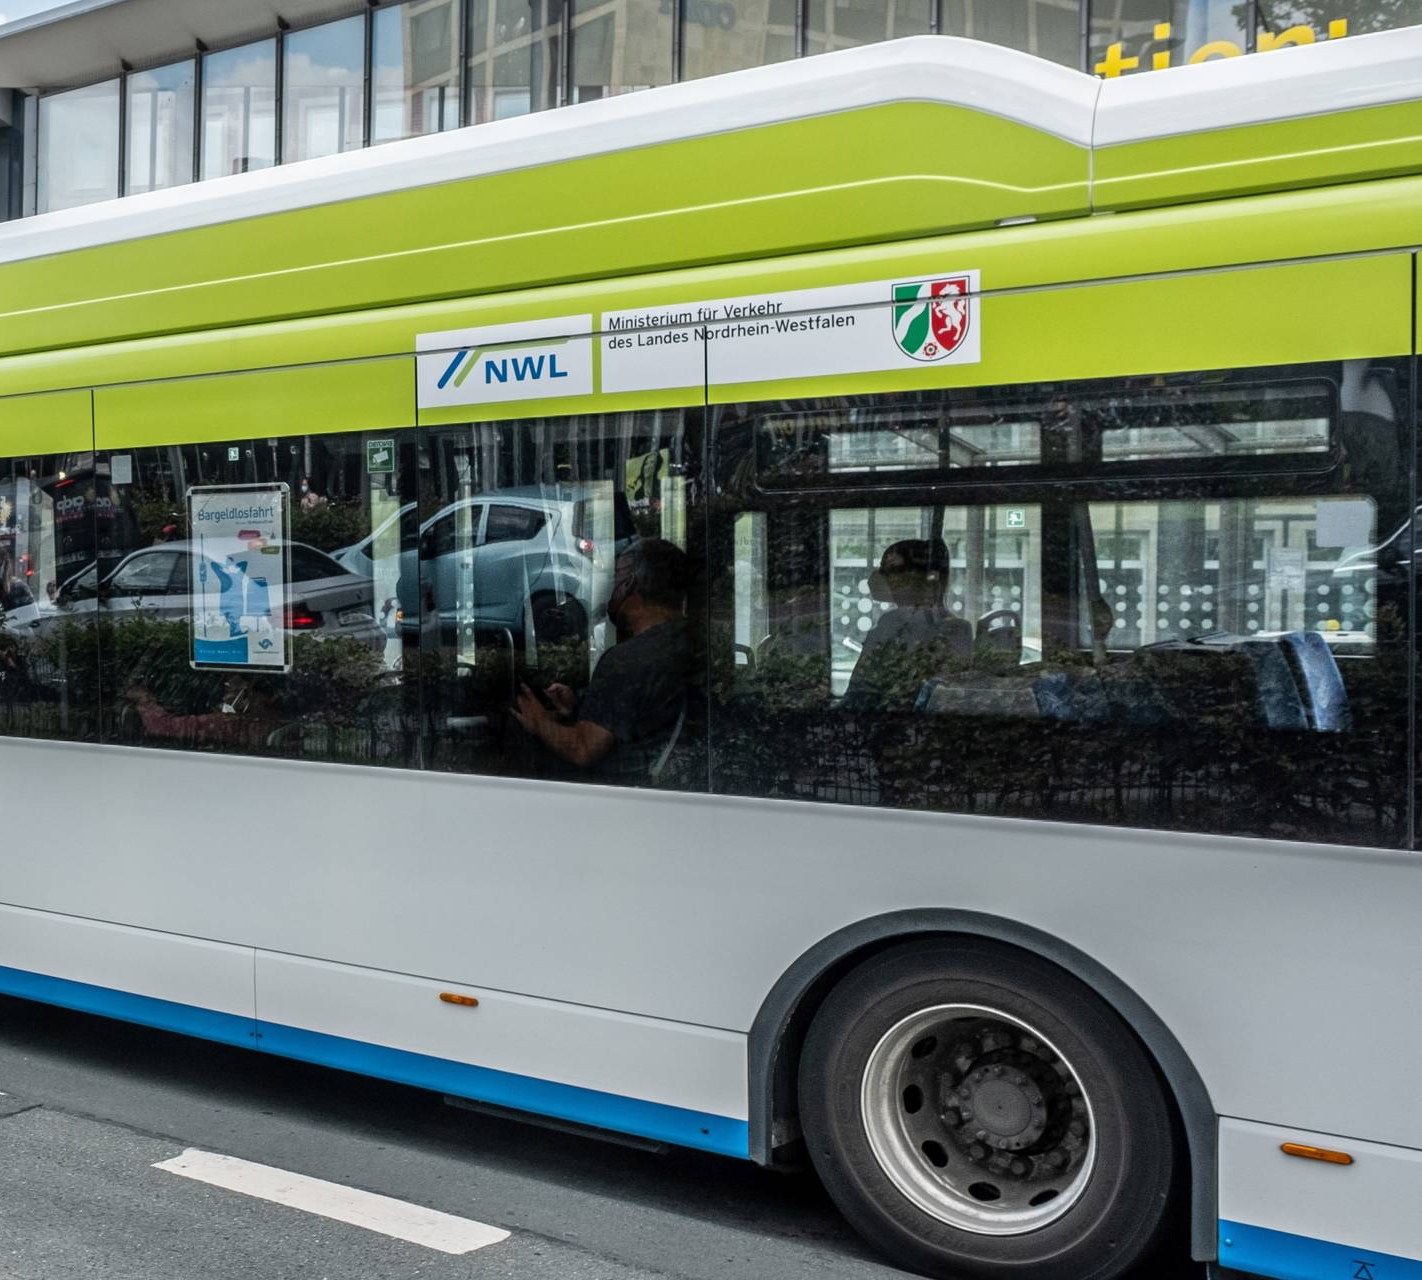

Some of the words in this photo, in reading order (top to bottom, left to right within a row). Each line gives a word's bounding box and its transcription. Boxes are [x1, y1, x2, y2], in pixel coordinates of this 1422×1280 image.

[609, 311, 692, 330] Ministerium
[698, 307, 718, 323] für
[724, 300, 783, 318] Verkehr
[608, 336, 633, 350] des
[638, 331, 689, 346] Landes
[694, 314, 856, 341] Nordrhein-Westfalen
[485, 353, 568, 385] NWL
[198, 506, 274, 523] Bargeldlosfahrt
